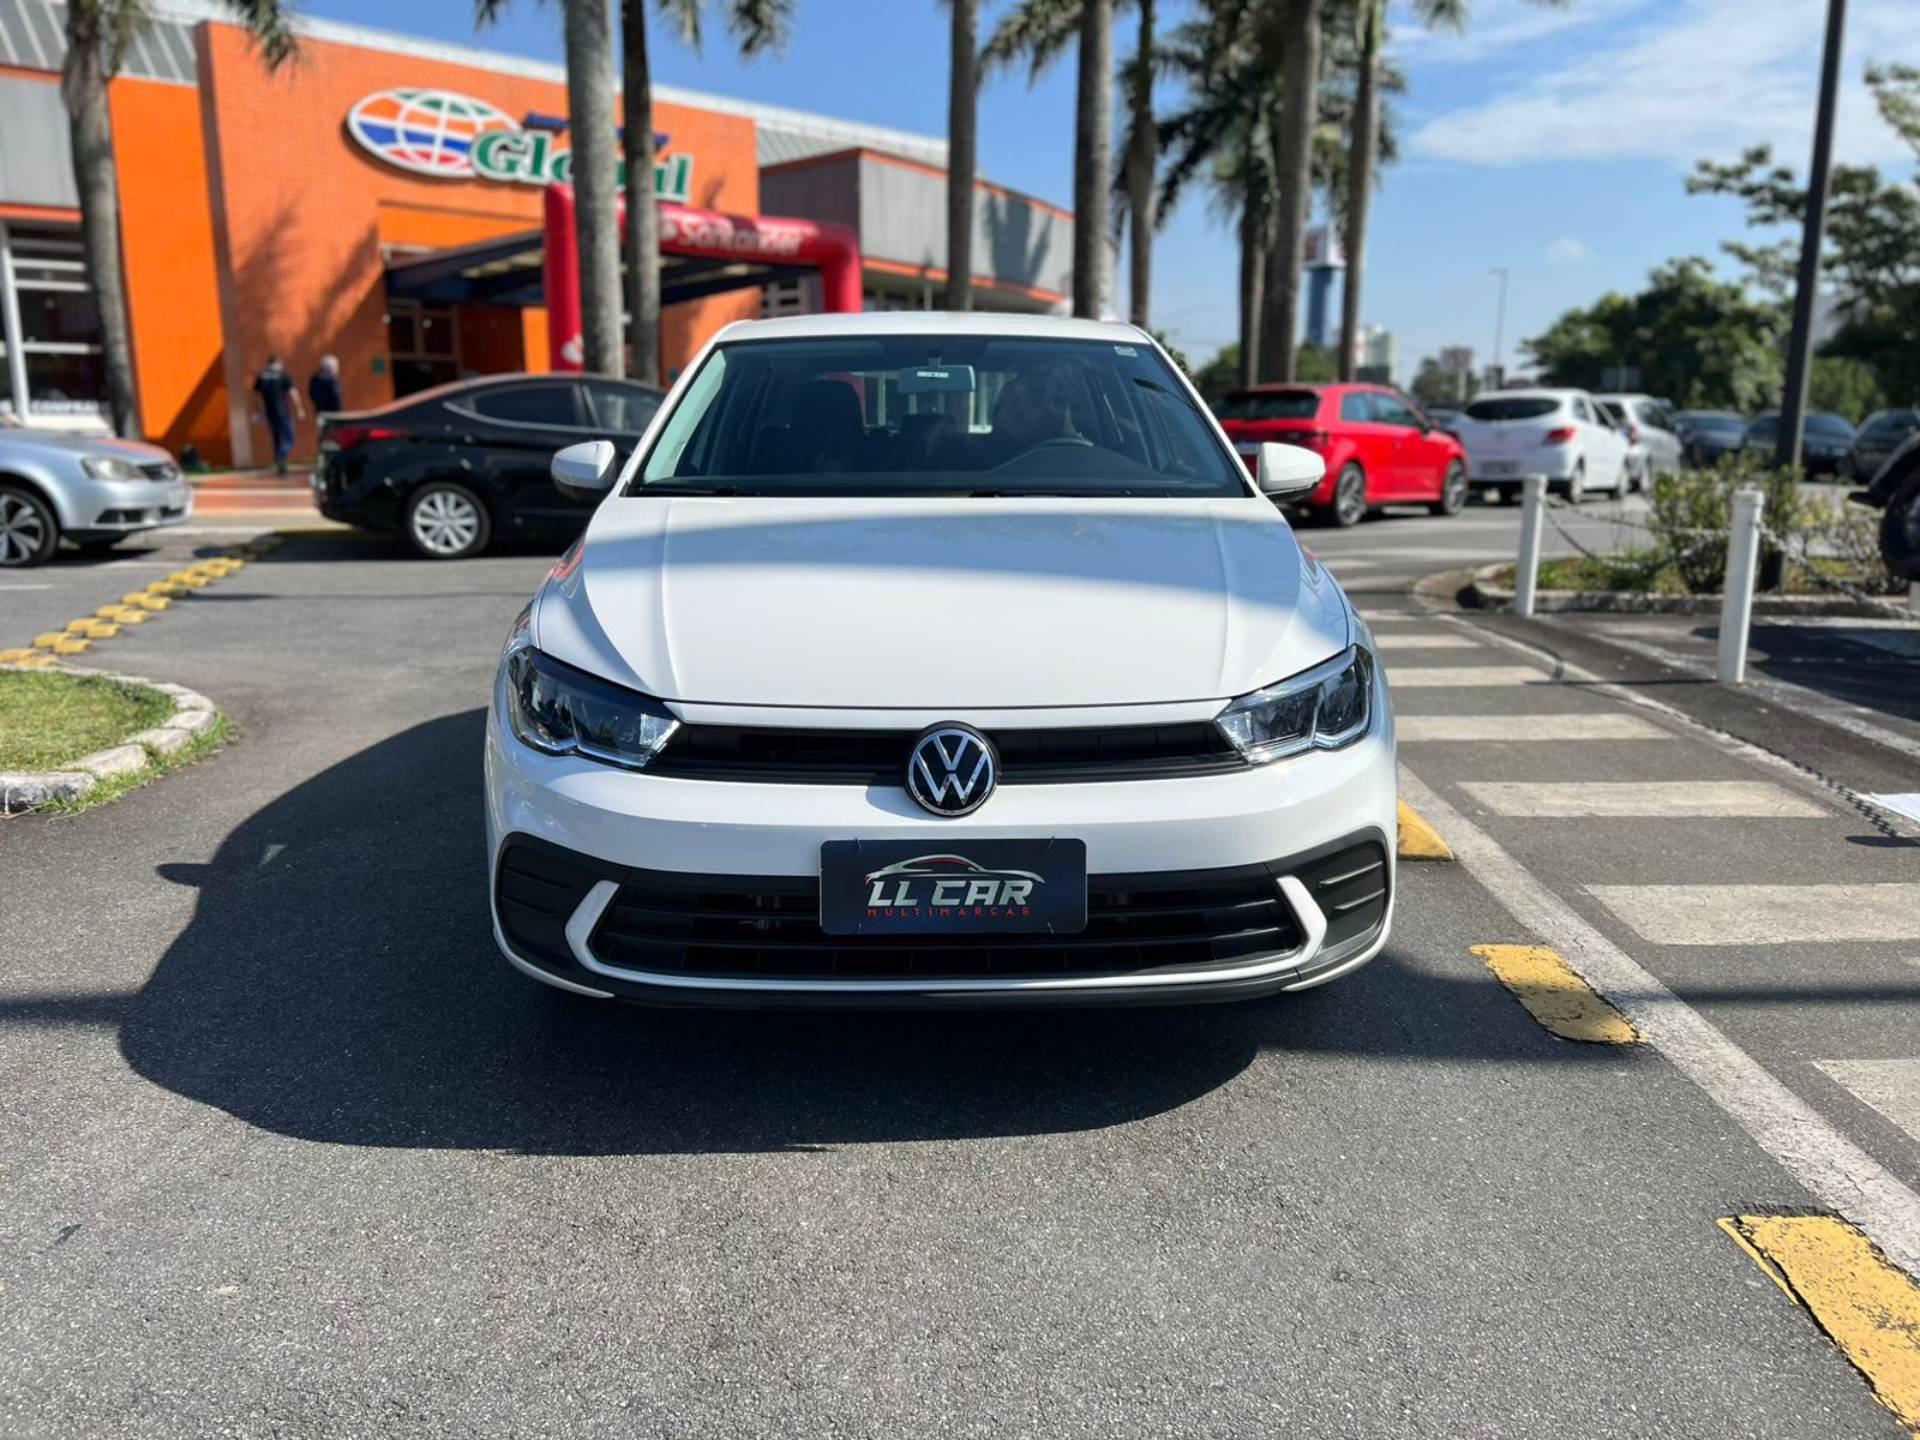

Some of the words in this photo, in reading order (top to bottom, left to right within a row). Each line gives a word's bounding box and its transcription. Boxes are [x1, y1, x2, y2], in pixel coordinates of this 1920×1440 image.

[471, 128, 694, 202] Glol
[679, 217, 804, 255] Santander
[868, 880, 918, 907] LL
[931, 879, 1034, 906] CAR
[867, 906, 1030, 917] MULTIMARCAS
